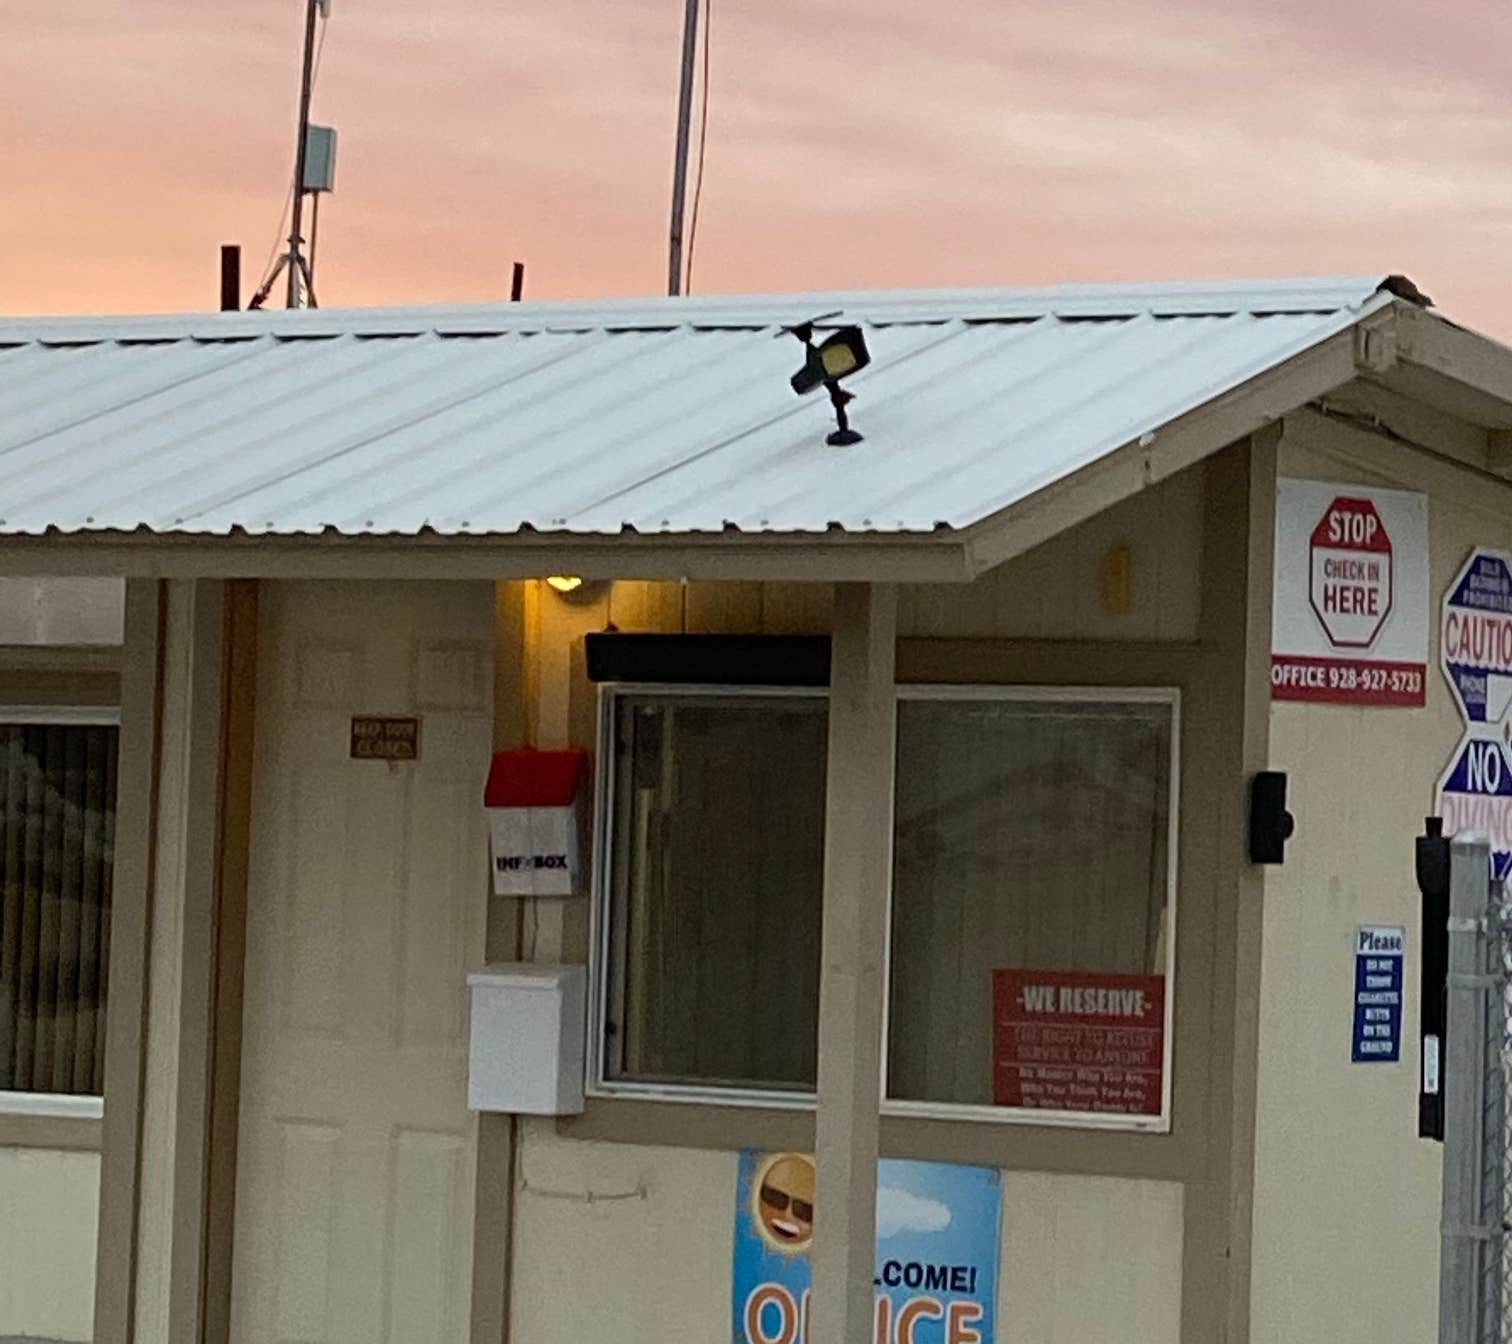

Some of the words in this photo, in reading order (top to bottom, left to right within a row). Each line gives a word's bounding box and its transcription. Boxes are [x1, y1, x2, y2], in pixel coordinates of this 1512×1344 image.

[1328, 511, 1377, 545] STOP
[1323, 558, 1363, 582] CHECK
[1364, 562, 1380, 583] IN
[1322, 584, 1379, 617] HERE
[1271, 662, 1326, 688] OFFICE
[1328, 667, 1422, 693] 928-927-5733
[1467, 742, 1501, 794] NO
[1359, 931, 1402, 951] Please
[874, 1260, 977, 1294] COME!
